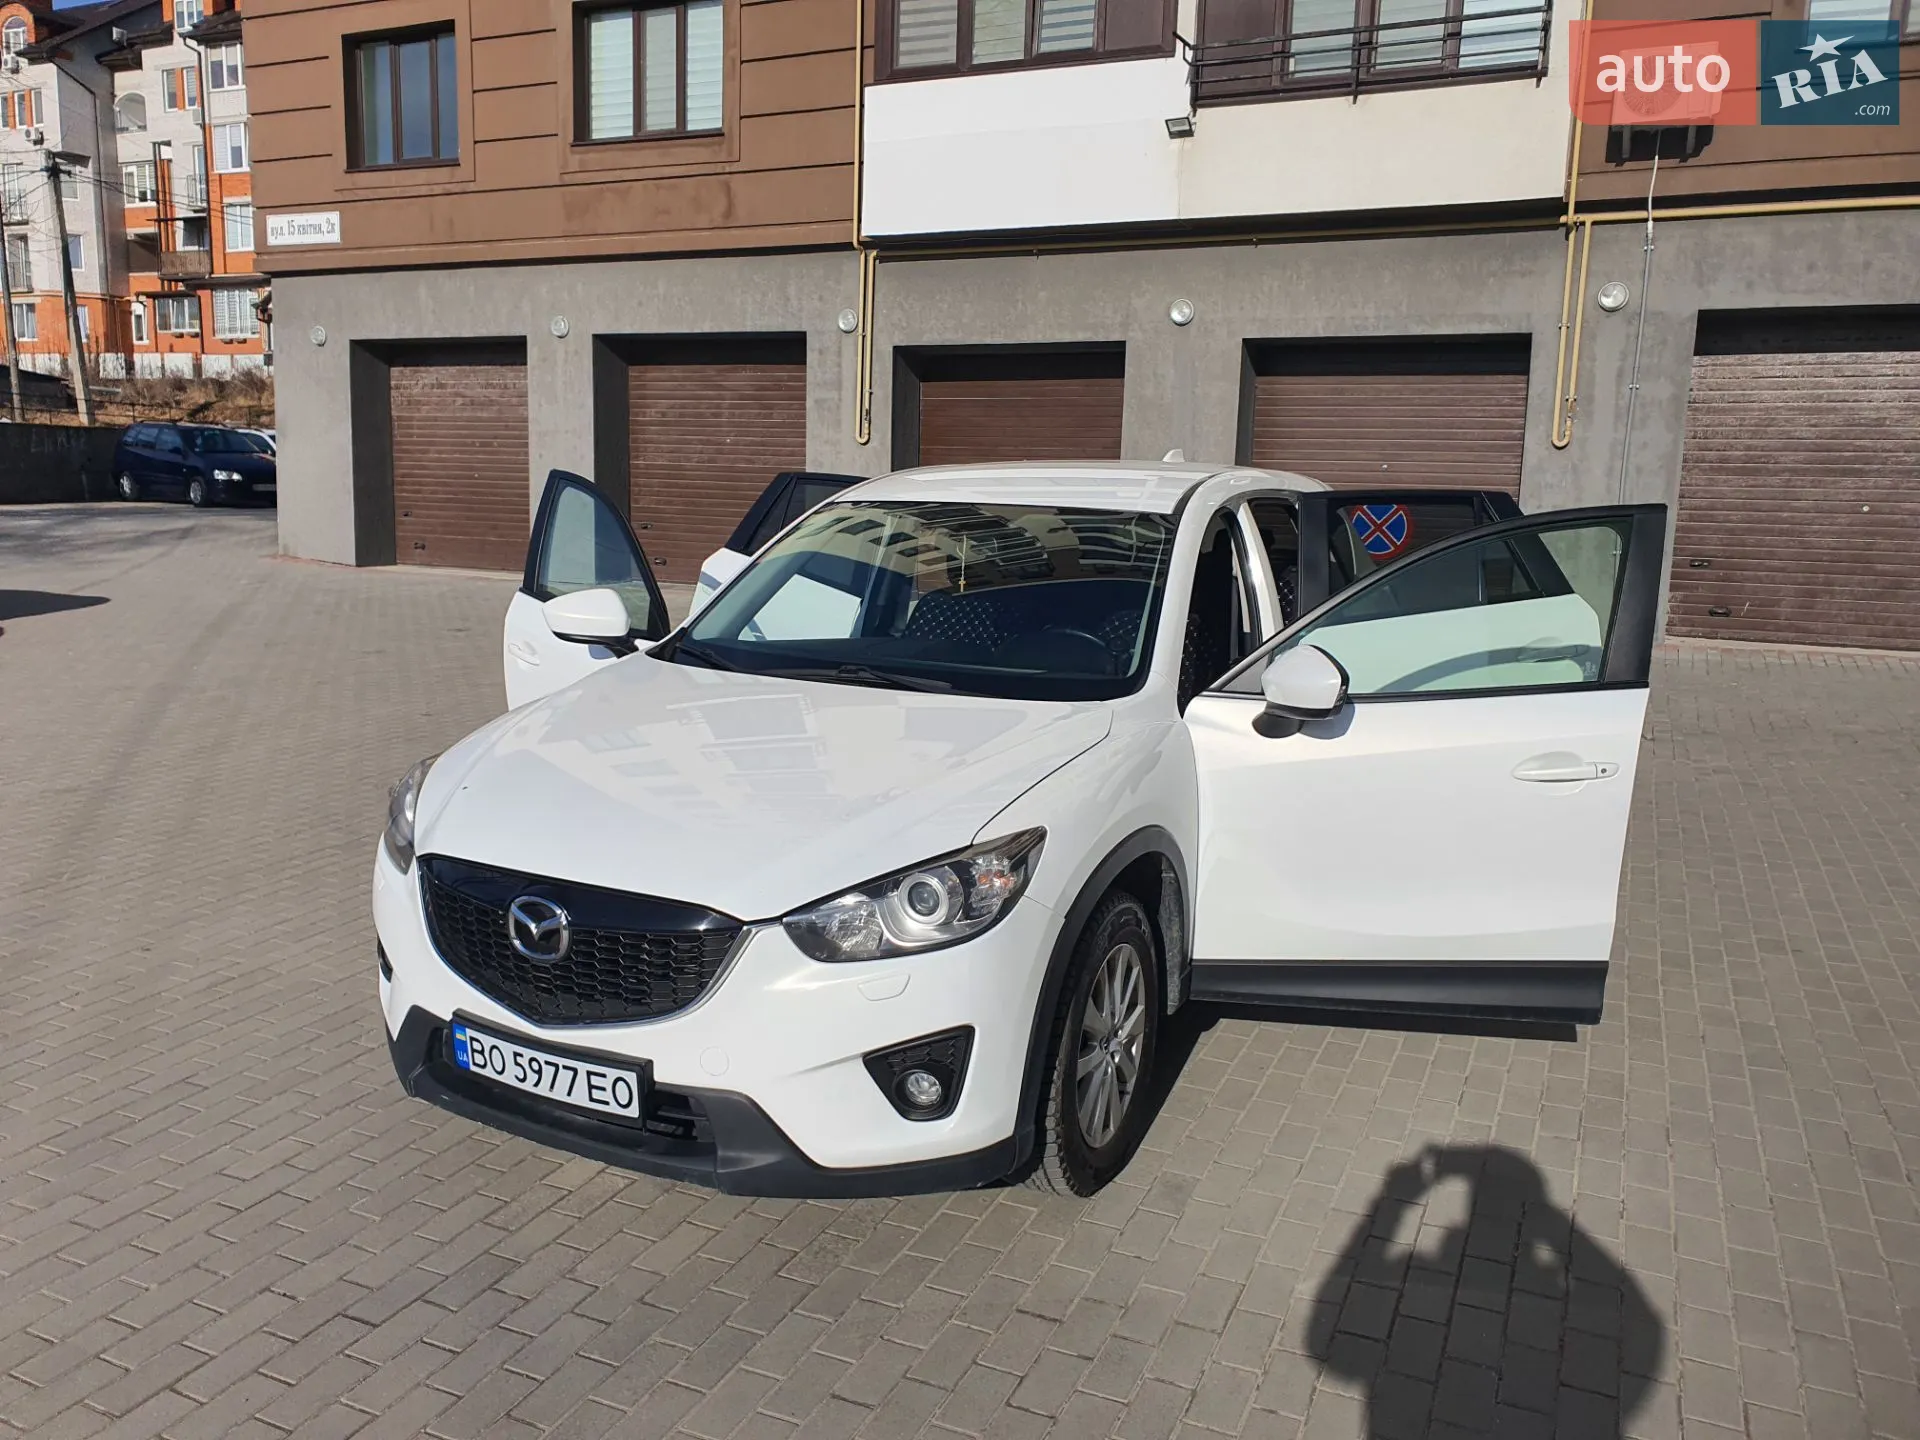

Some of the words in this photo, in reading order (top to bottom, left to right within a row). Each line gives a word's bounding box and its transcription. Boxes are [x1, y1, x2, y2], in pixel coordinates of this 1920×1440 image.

[270, 225, 286, 240] вул.
[287, 219, 296, 236] 15
[297, 219, 325, 236] квітня,
[457, 1051, 469, 1063] UA
[469, 1035, 506, 1076] BO
[512, 1051, 578, 1097] 5977
[586, 1070, 633, 1110] EO
